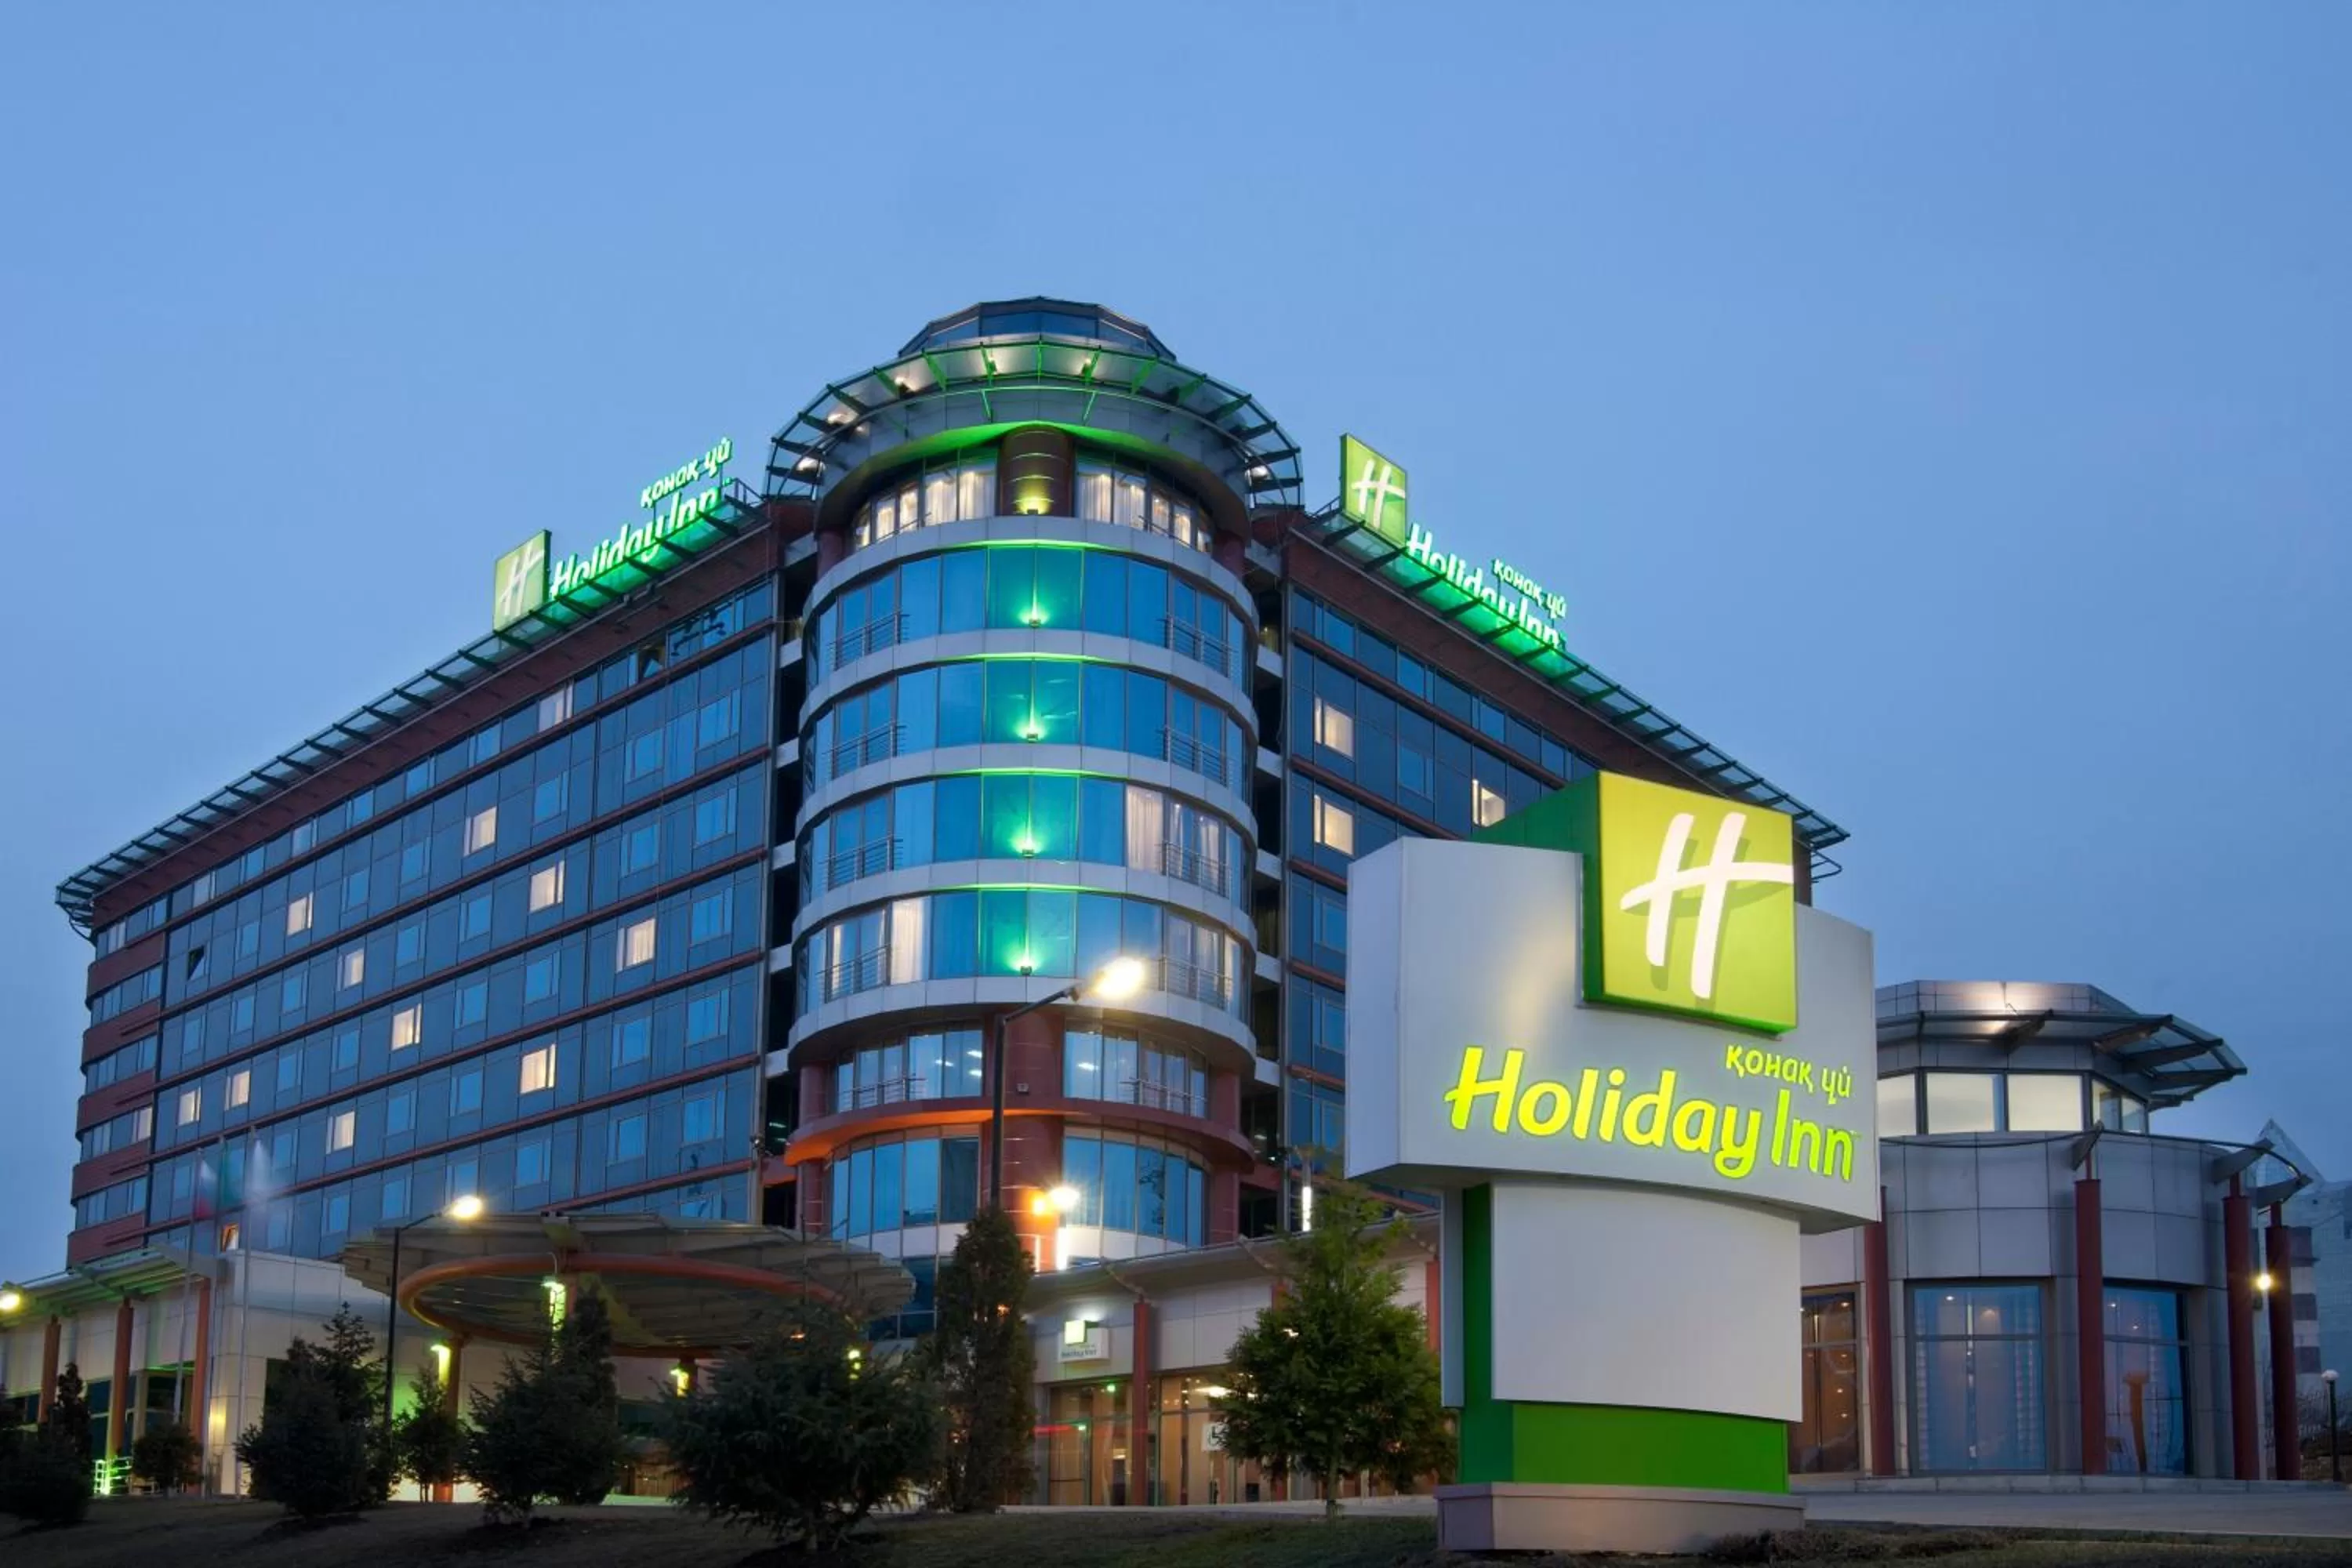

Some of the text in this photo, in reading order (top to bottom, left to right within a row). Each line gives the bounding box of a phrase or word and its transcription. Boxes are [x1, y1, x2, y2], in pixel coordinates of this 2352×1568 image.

[550, 490, 722, 600] Holiday Inn
[1518, 596, 1559, 649] Inn
[1444, 1046, 1853, 1181] Holiday Inn
